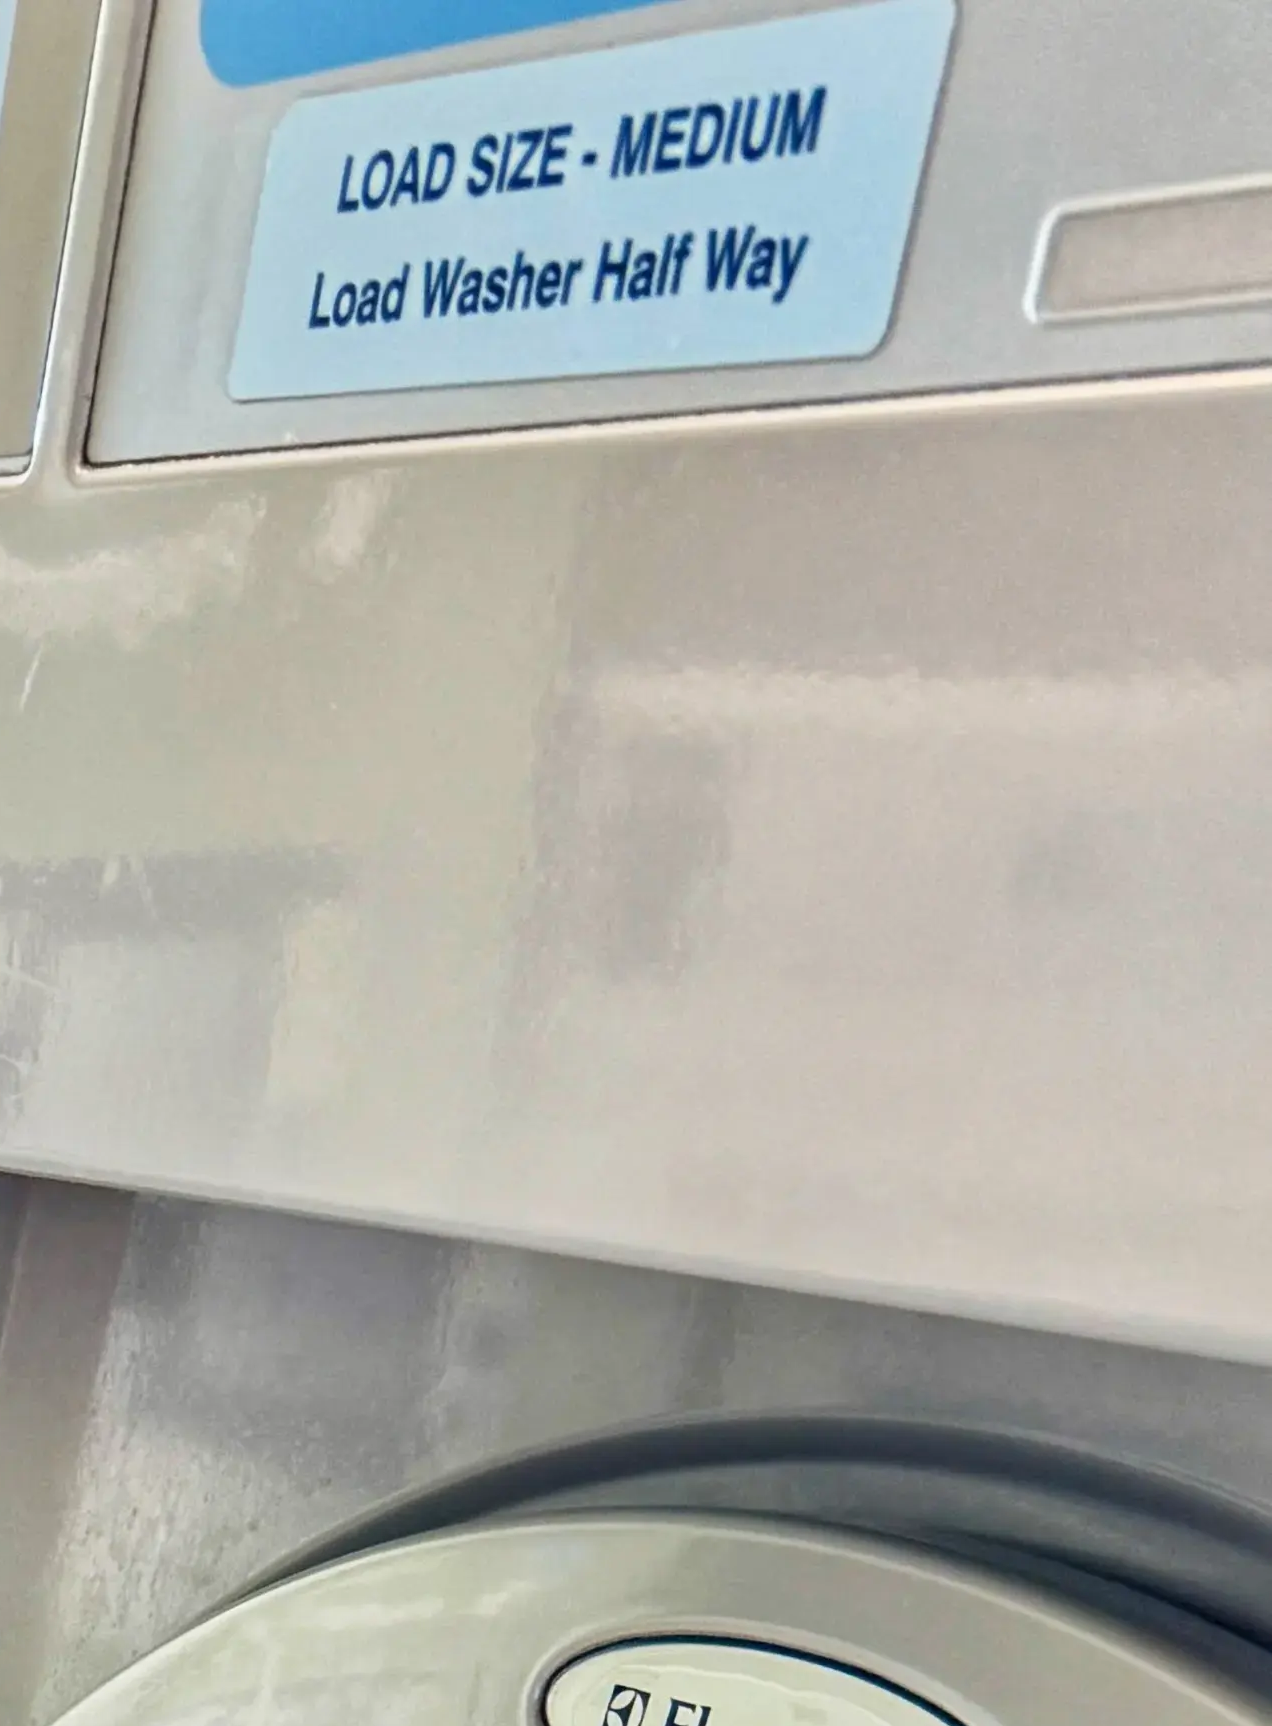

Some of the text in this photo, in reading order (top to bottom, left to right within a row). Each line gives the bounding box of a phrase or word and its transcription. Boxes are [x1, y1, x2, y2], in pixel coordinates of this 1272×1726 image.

[337, 85, 827, 214] LOAD SIZE - MEDIUM
[308, 224, 811, 330] Load Washer Half Way
